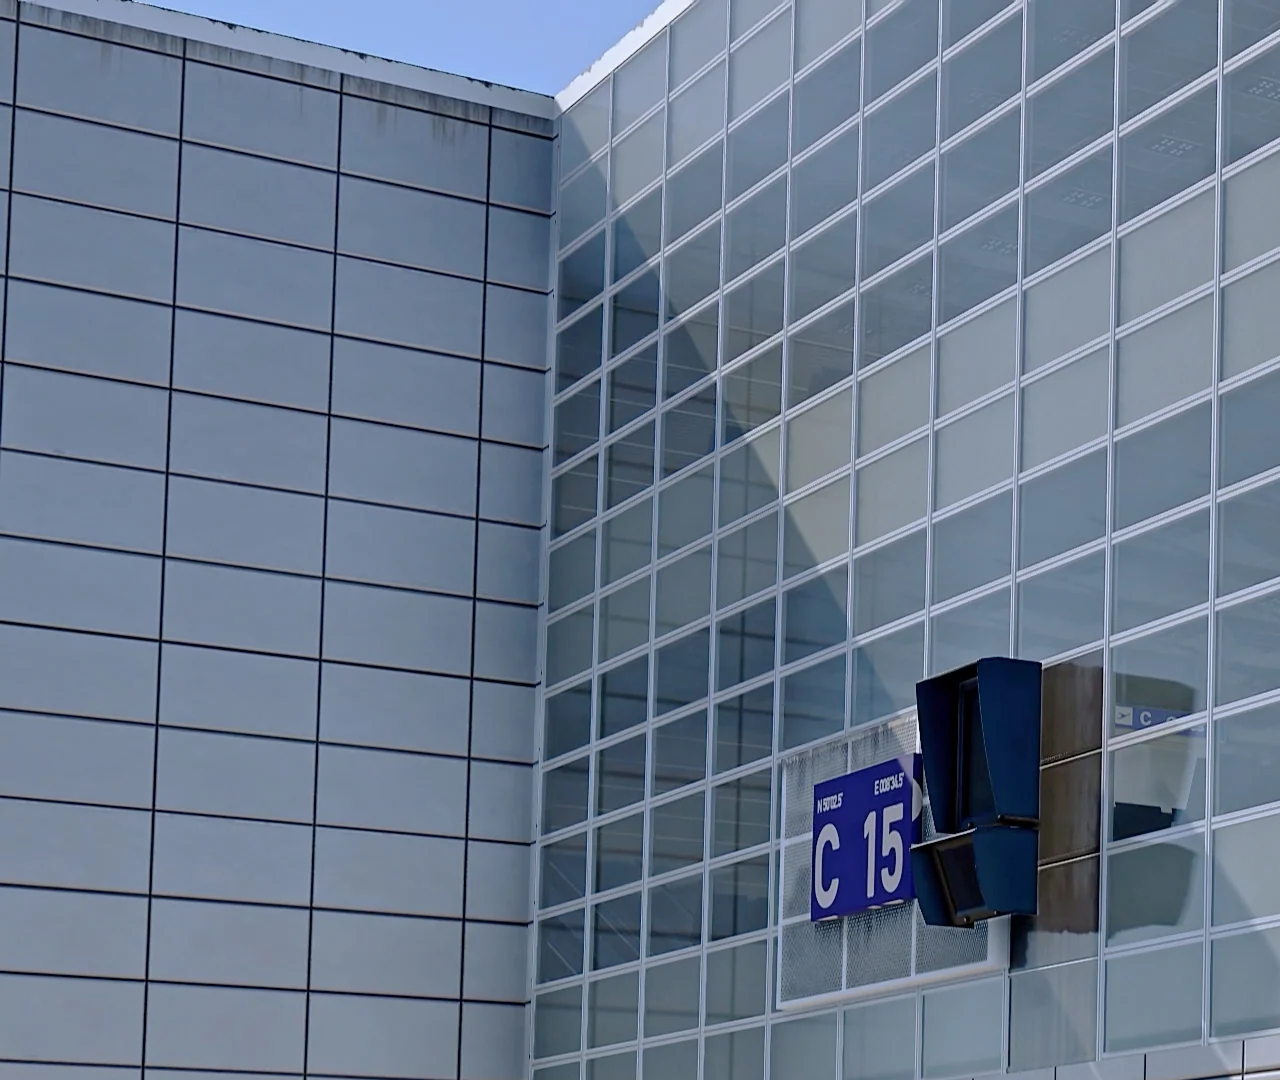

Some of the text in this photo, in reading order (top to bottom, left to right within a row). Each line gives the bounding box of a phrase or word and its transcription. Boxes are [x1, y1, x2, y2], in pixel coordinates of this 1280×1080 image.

[1140, 711, 1152, 726] C
[874, 779, 880, 796] E
[815, 802, 904, 909] C 15
